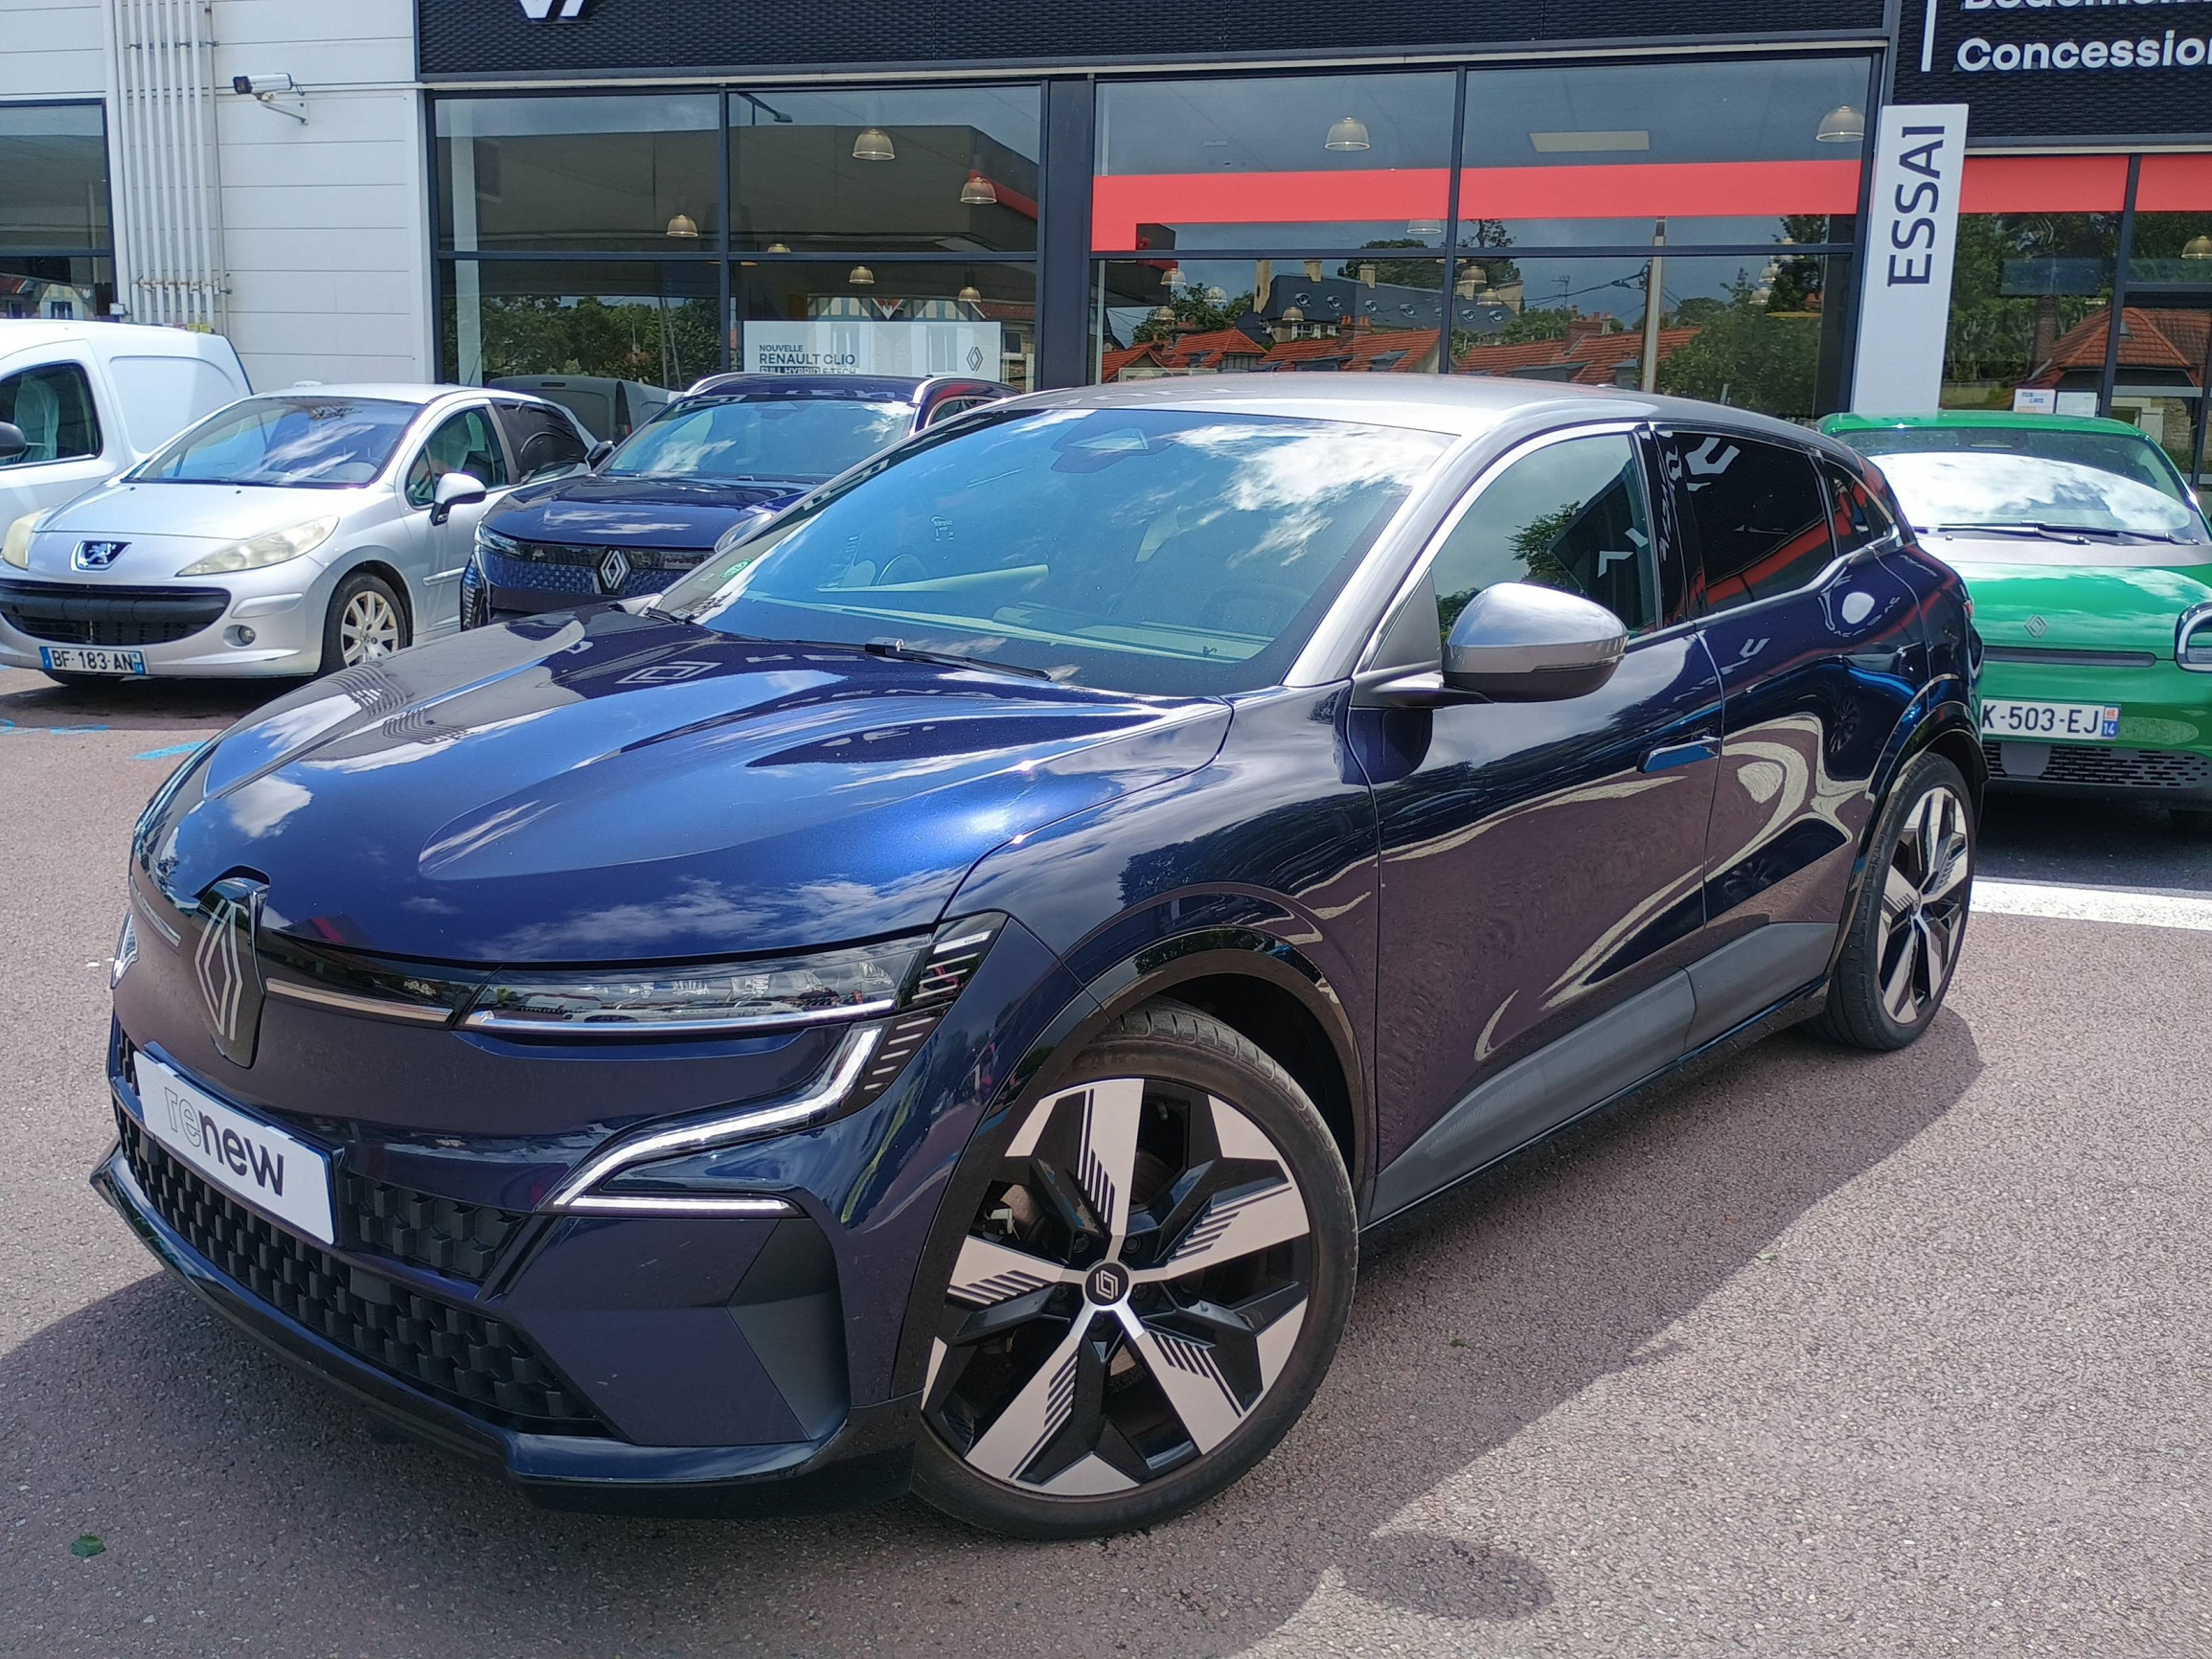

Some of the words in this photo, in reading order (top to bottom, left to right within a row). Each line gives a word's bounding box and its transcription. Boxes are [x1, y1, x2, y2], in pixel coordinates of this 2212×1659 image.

[1956, 29, 2212, 72] Concessio
[1887, 125, 1946, 287] ESSAI
[759, 344, 804, 352] NOUVELLE
[759, 353, 821, 365] RENAULT
[823, 353, 855, 365] CLIO
[51, 649, 135, 671] BF-183-AN
[1981, 705, 2100, 735] K-503-EJ
[2103, 722, 2115, 736] 14
[164, 1085, 285, 1197] renew
